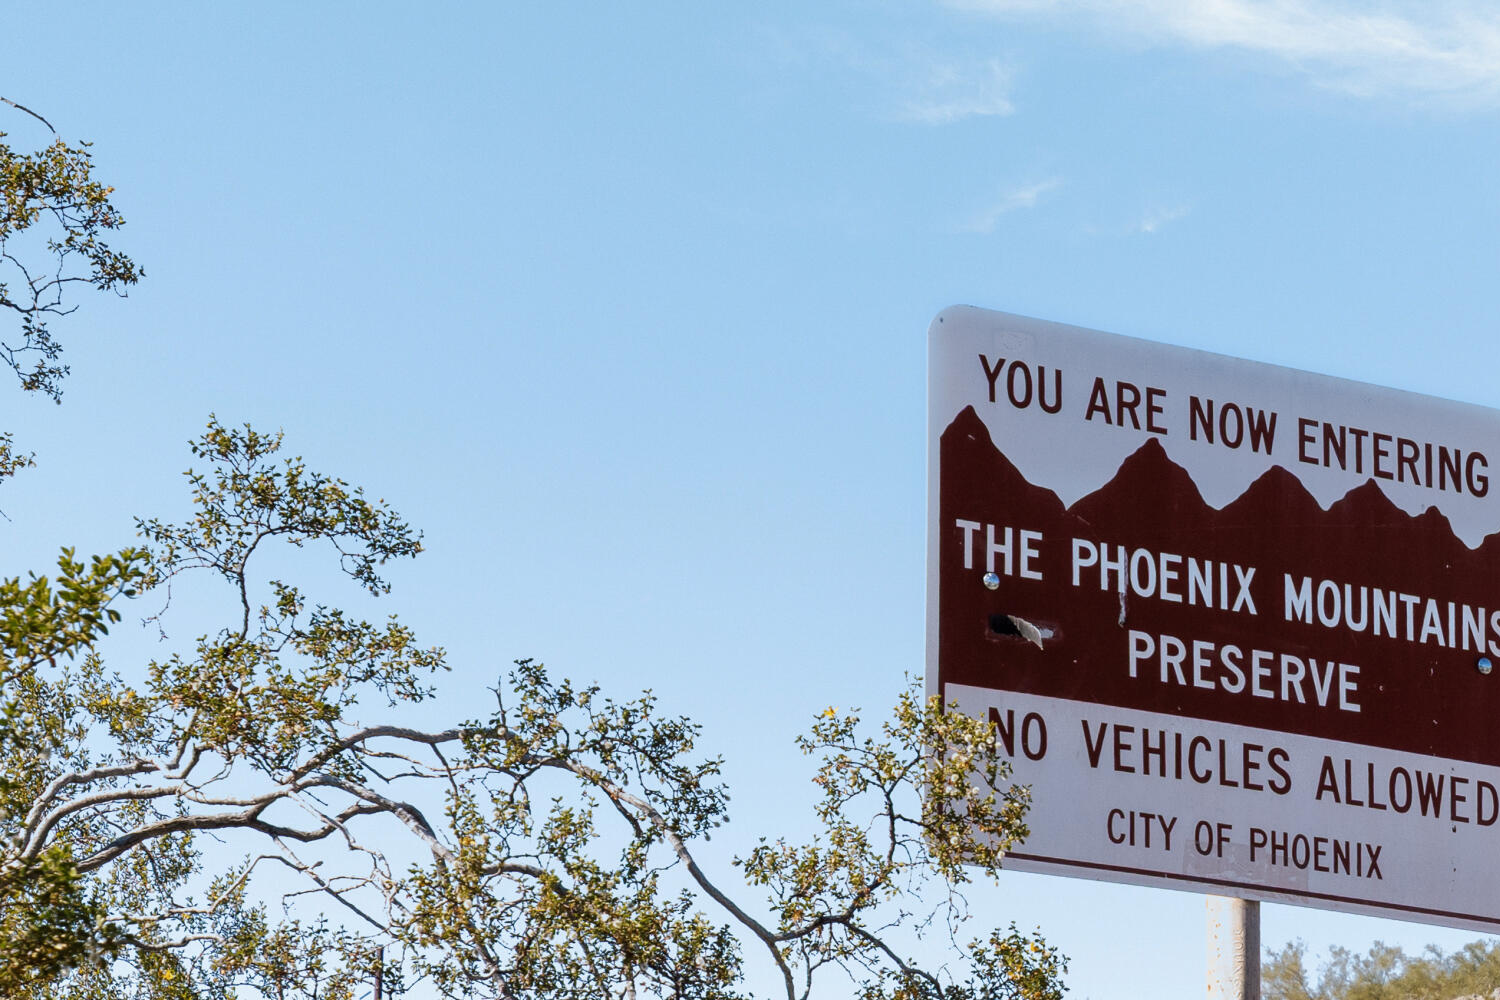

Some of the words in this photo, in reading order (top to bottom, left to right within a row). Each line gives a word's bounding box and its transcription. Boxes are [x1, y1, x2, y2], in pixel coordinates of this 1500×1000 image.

[978, 354, 1063, 414] YOU
[1085, 377, 1168, 435] ARE
[1189, 396, 1278, 455] NOW
[1299, 417, 1489, 498] ENTERING
[955, 518, 1043, 580] THE
[1072, 538, 1257, 615] PHOENIX
[1128, 630, 1361, 712] PRESERVE
[988, 706, 1048, 761] NO
[1081, 719, 1292, 795] VEHICLES
[1315, 756, 1500, 826] ALLOWED
[1107, 809, 1178, 851] CITY
[1194, 820, 1232, 858] OF
[1249, 827, 1383, 879] PHOENIX
